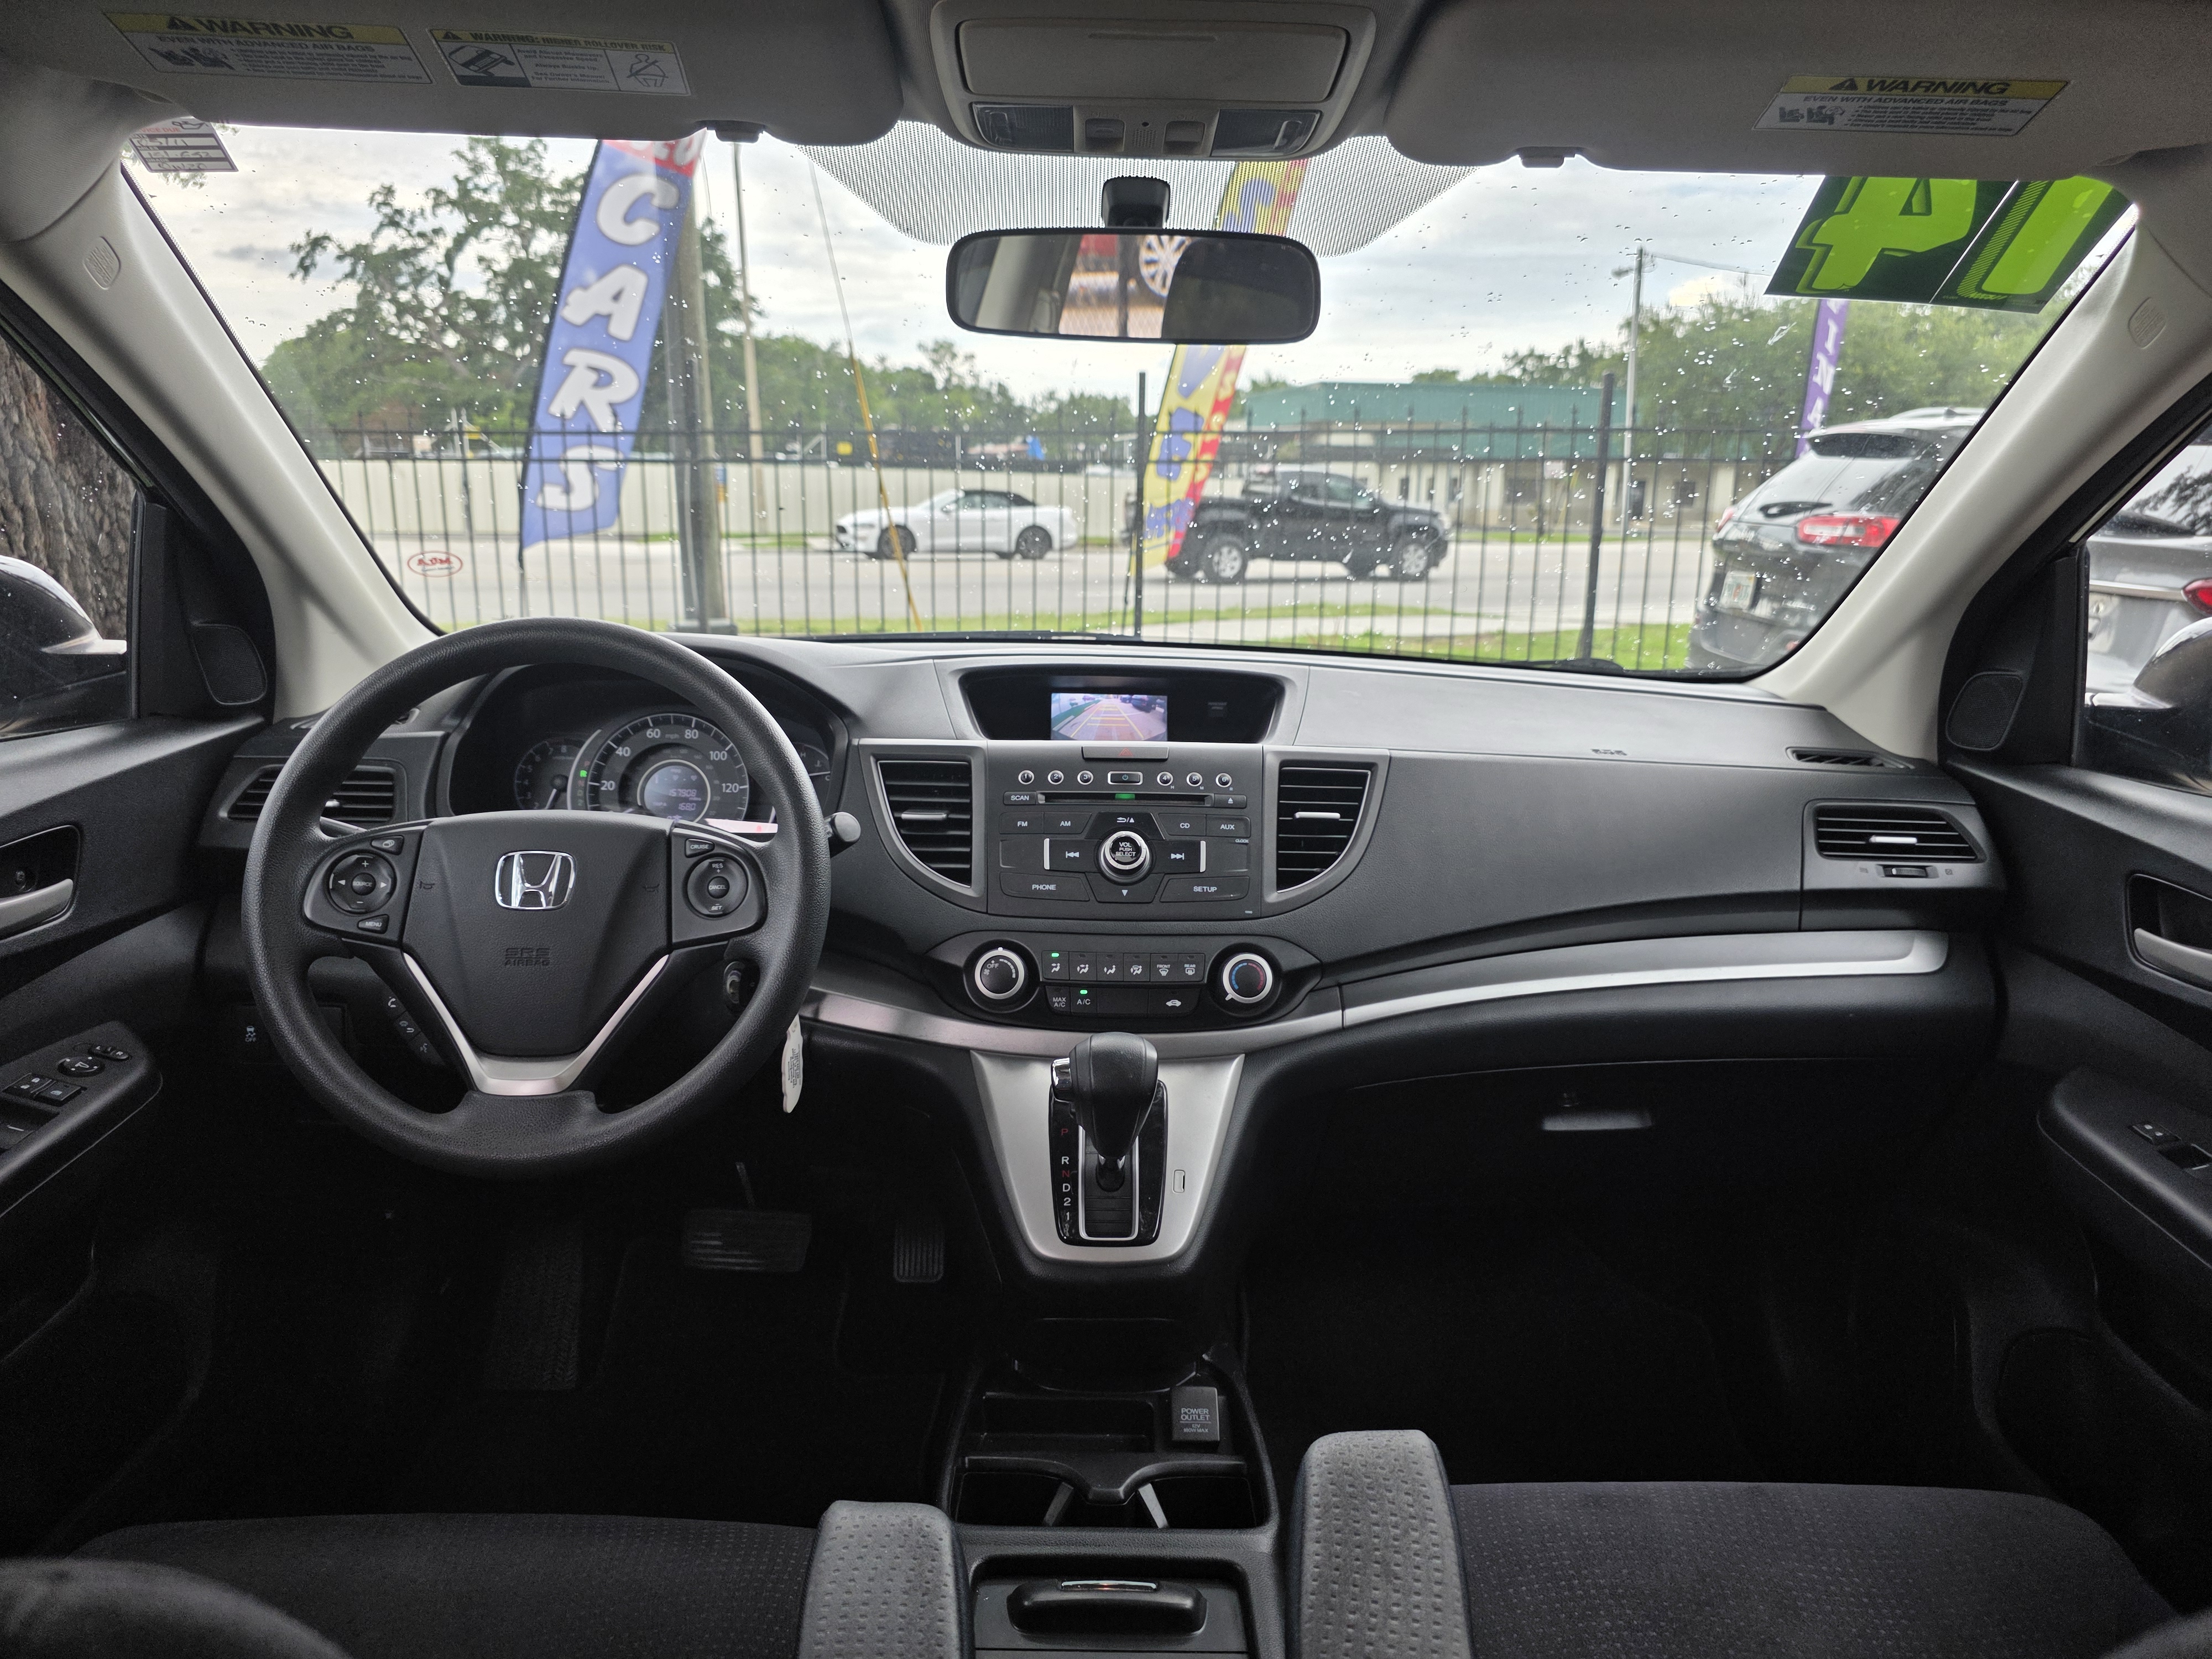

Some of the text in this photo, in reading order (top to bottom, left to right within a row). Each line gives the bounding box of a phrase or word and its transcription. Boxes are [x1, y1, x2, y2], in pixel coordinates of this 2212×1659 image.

[193, 18, 355, 39] WARNING
[233, 39, 310, 49] ADVANCED
[582, 40, 640, 50] ROLLOVER
[1860, 79, 2014, 95] WARNING
[536, 173, 679, 512] CARS
[646, 728, 661, 738] 60
[684, 729, 698, 739] 80
[615, 747, 727, 760] 40 100
[600, 780, 739, 793] 20 120
[505, 947, 551, 959] SRS
[504, 959, 551, 967] AIRBAG
[1061, 1128, 1068, 1136] P
[1061, 1156, 1070, 1165] R
[1062, 1170, 1070, 1178] N
[1062, 1183, 1071, 1192] D
[1063, 1197, 1071, 1206] 2
[1066, 1211, 1070, 1221] 1
